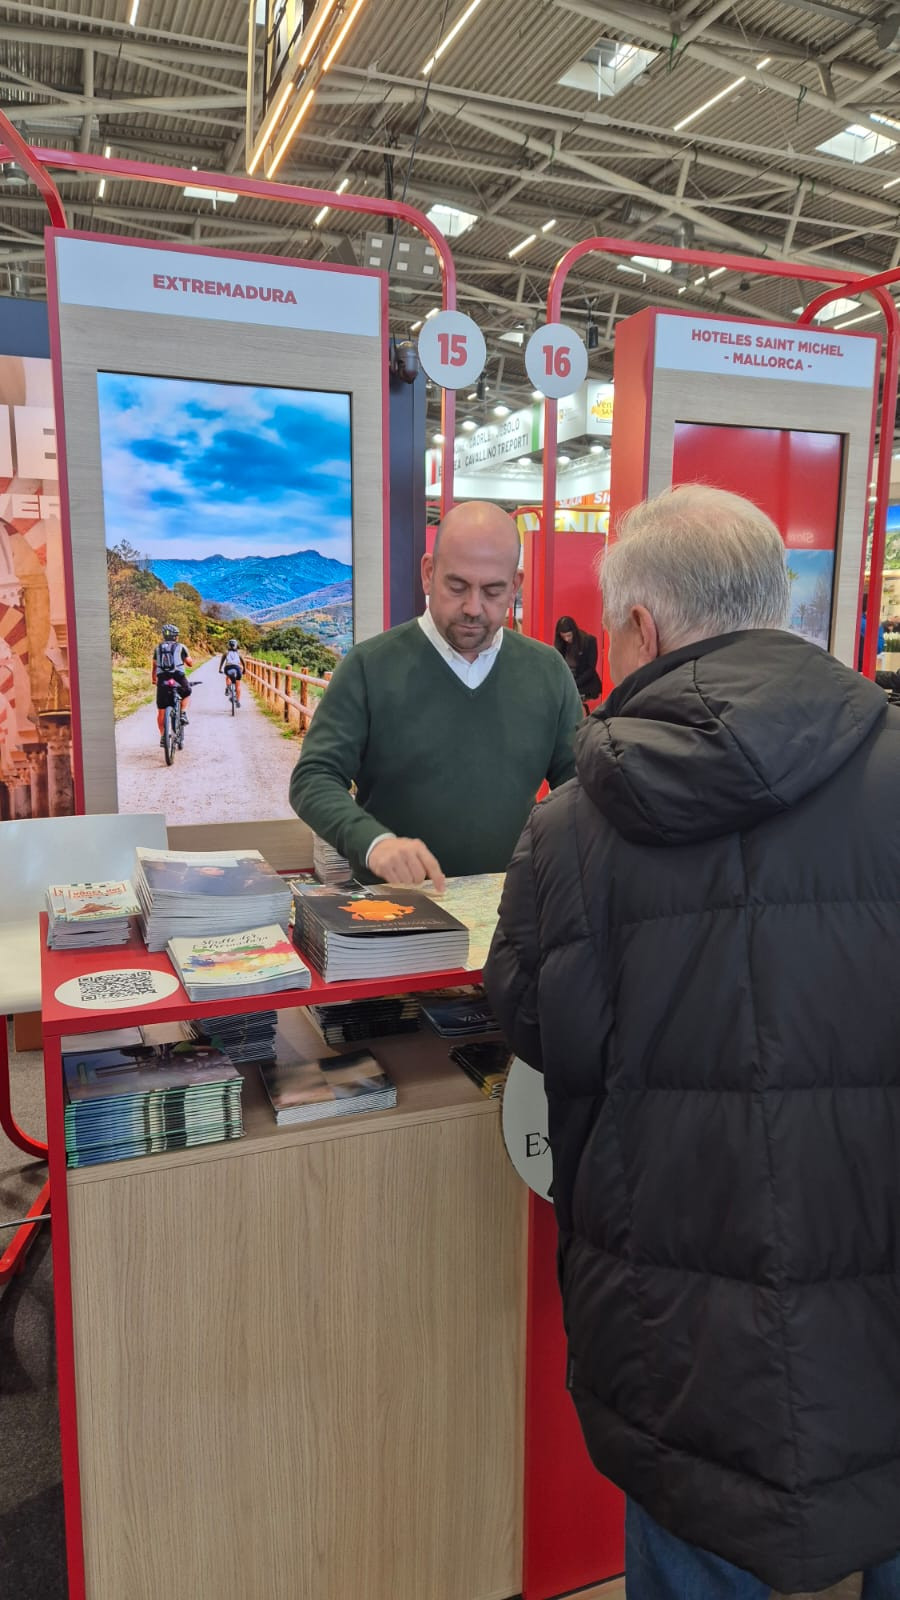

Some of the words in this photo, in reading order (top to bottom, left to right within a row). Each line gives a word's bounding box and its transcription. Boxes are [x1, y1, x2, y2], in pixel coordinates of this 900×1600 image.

[153, 274, 298, 304] EXTREMADURA
[437, 333, 467, 366] 15
[691, 329, 752, 347] HOTELES
[755, 337, 795, 351] SAINT
[797, 341, 844, 357] MICHEL
[542, 345, 571, 378] 16
[732, 352, 804, 371] MALLORCA
[465, 444, 497, 467] CAVALLINO
[498, 433, 529, 454] TREPORTI
